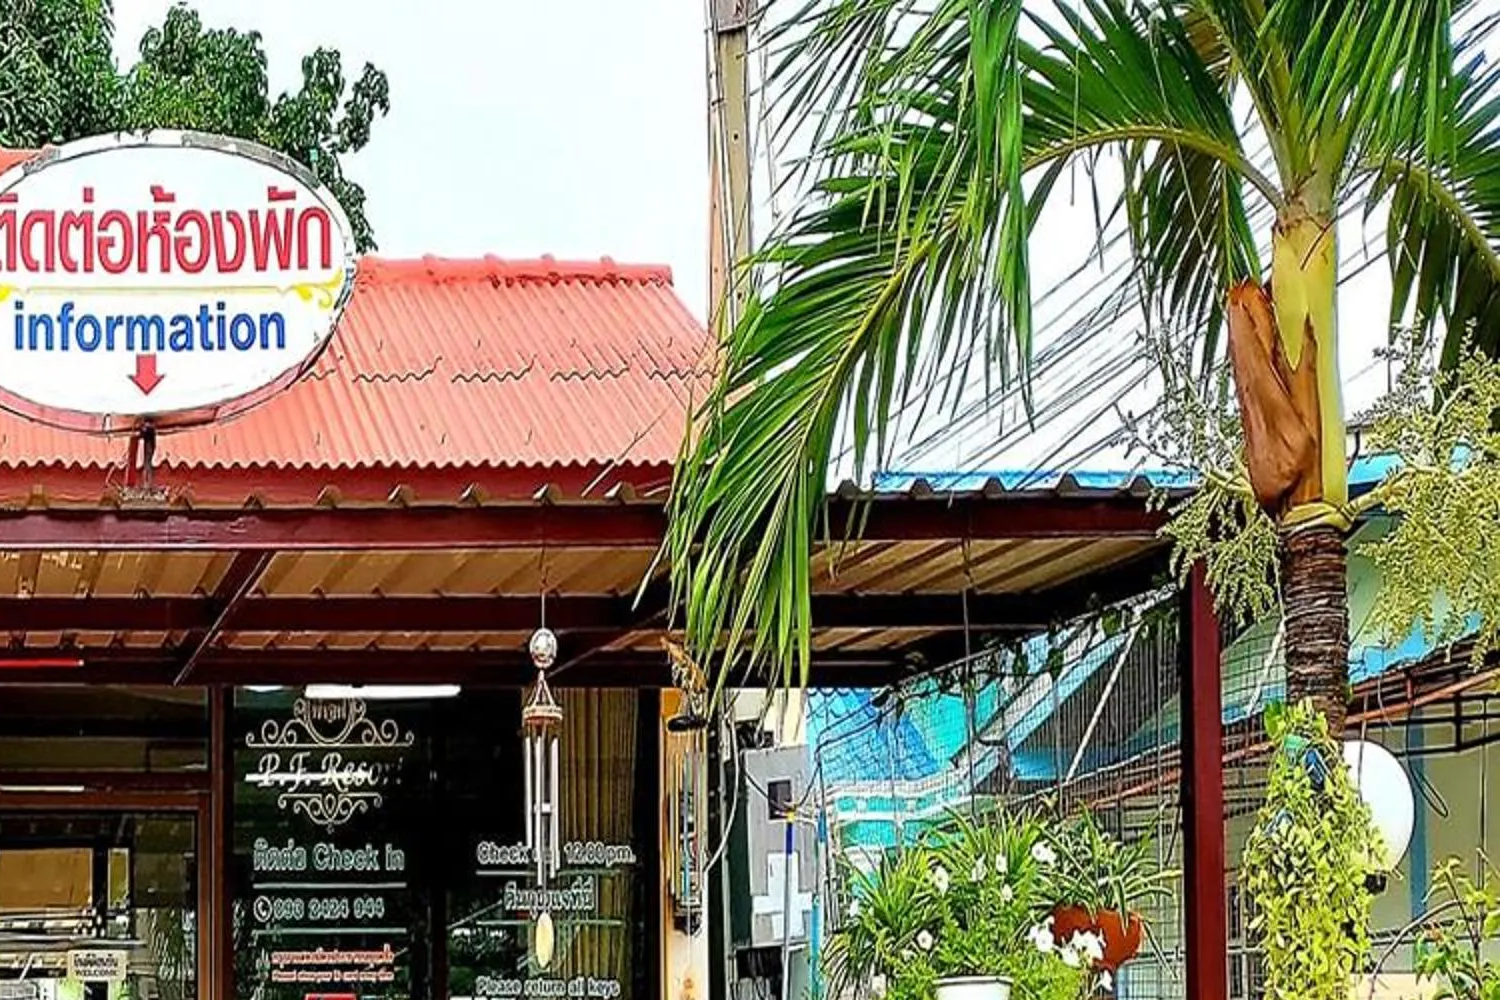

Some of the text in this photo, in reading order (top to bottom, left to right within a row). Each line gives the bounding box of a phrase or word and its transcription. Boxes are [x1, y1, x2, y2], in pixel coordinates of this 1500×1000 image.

[14, 301, 286, 351] information
[320, 752, 404, 793] Reso
[313, 843, 380, 871] Check
